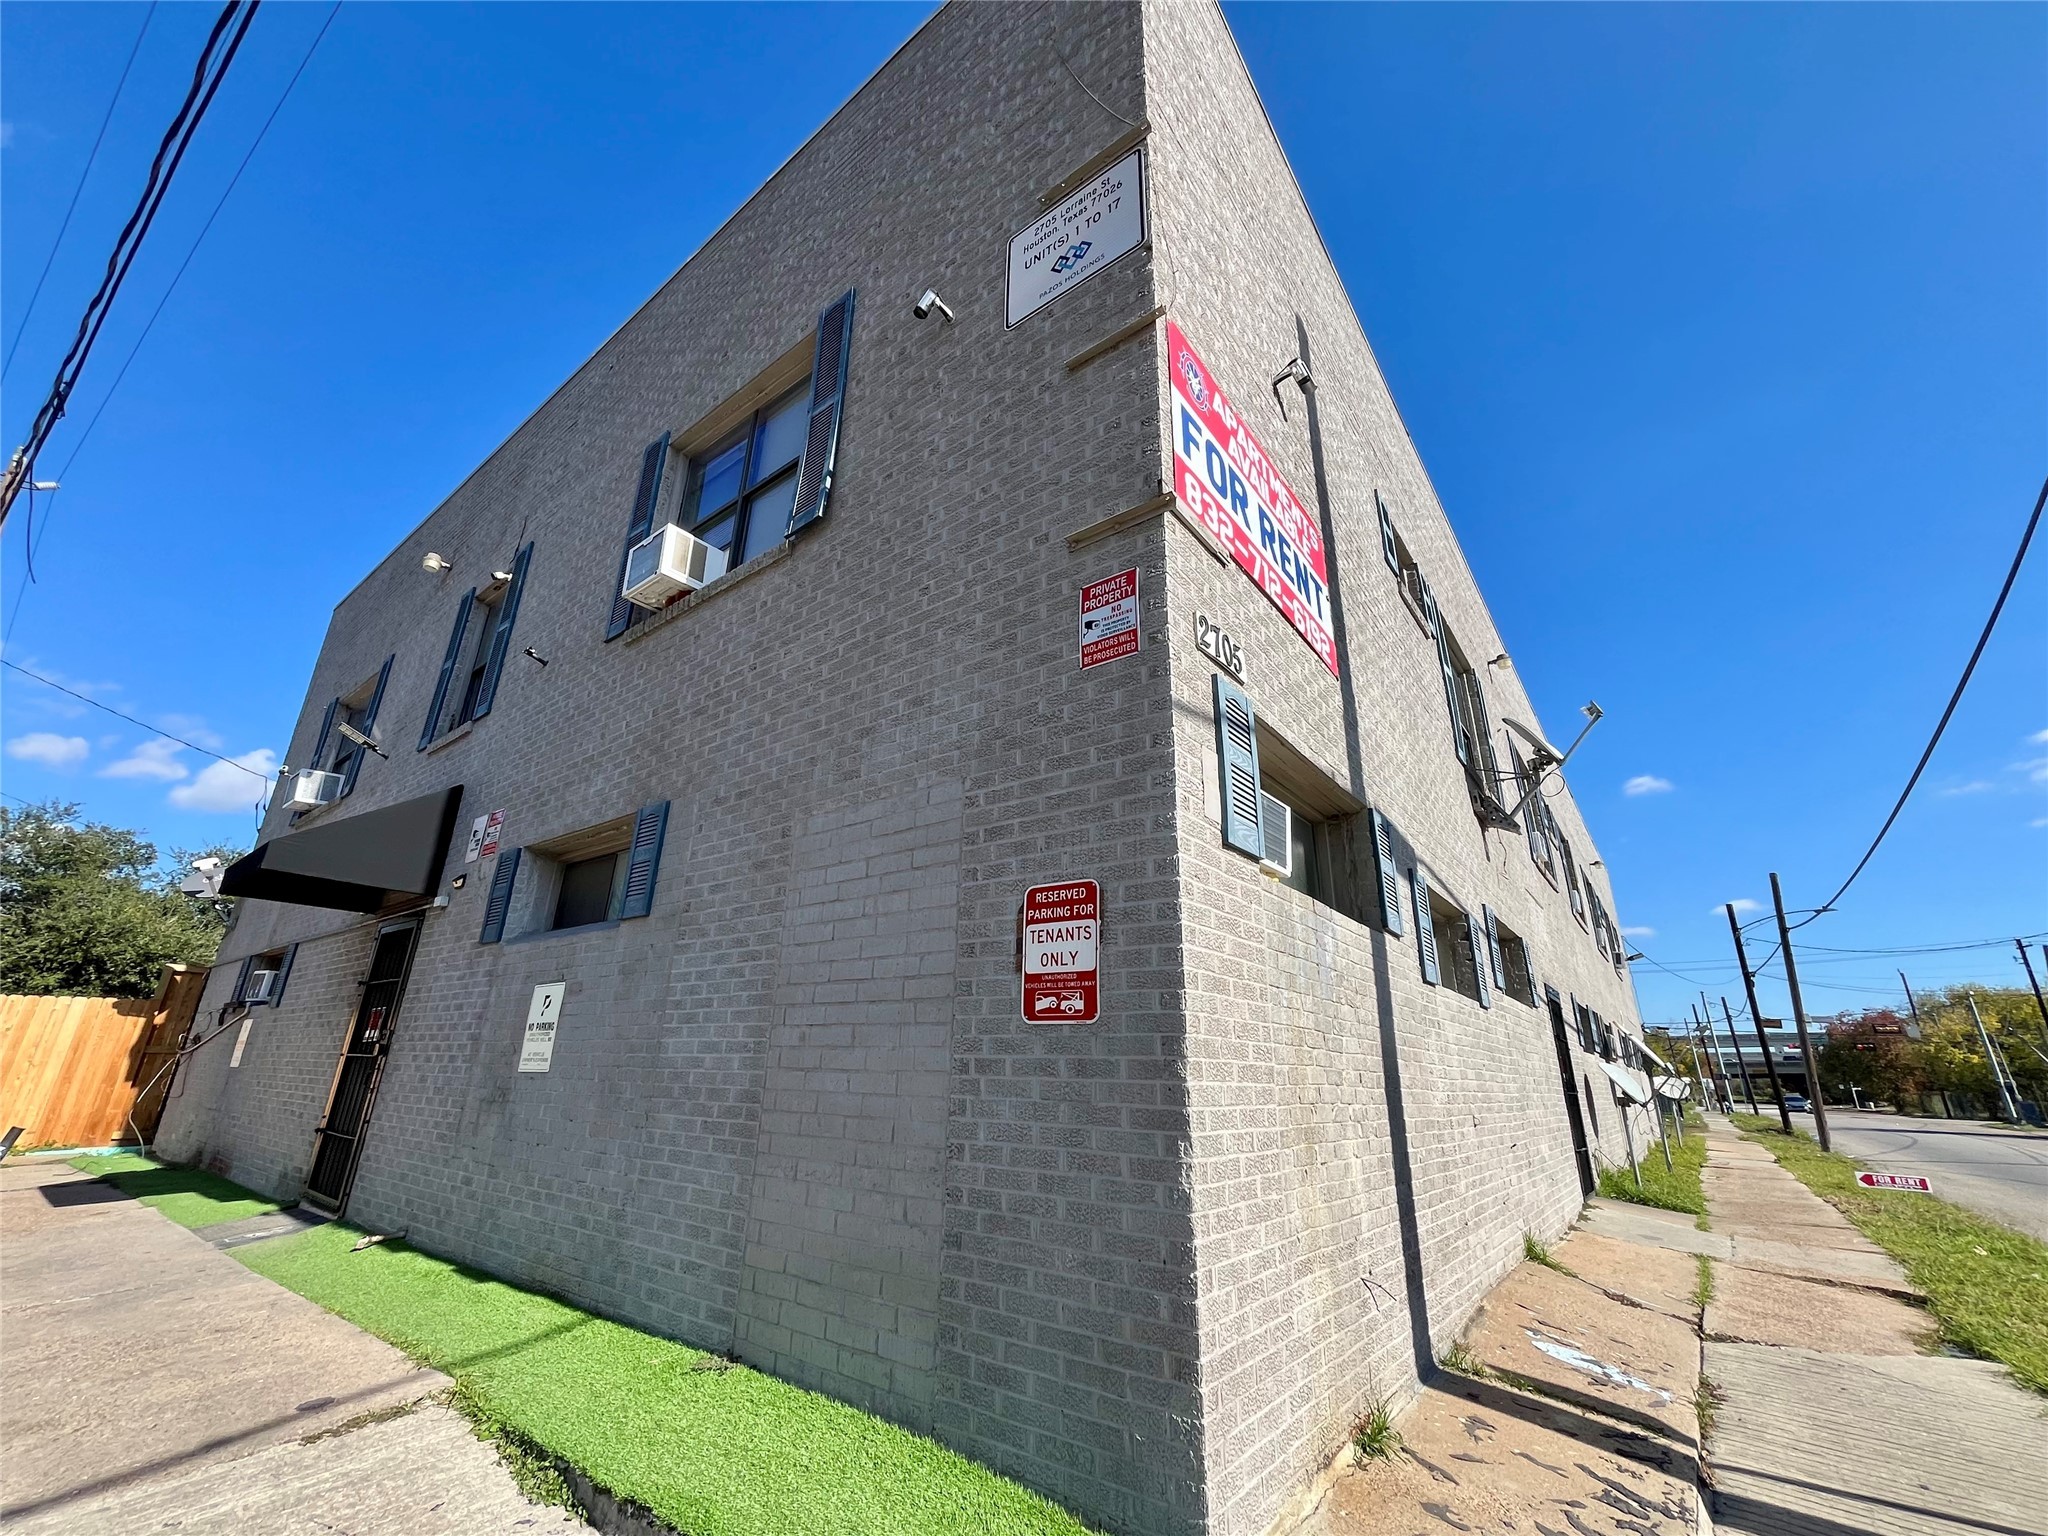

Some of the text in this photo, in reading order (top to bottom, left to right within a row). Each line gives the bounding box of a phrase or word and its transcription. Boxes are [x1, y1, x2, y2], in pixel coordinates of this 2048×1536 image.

[1034, 177, 1111, 237] 2705 Lorraine St
[1063, 205, 1088, 227] Texas
[1091, 180, 1123, 207] 77026
[1024, 197, 1122, 270] UNIT(S) 1 TO 17
[1039, 253, 1106, 299] PAZOS HOLDINGS
[1212, 391, 1319, 551] APARTMENTS
[1181, 403, 1323, 621] FOR RENT
[1227, 435, 1314, 566] AVAILABLE
[1184, 471, 1333, 667] 832-712-6192
[1084, 584, 1133, 612] PROPERTY
[1089, 575, 1128, 599] PRIVATE
[1111, 603, 1122, 613] NO
[1083, 631, 1136, 655] VIOLATORS WILL
[1083, 641, 1136, 665] BE PROSECUTED
[1198, 614, 1243, 675] 2705
[1035, 887, 1086, 904] RESERVED
[1027, 903, 1094, 920] PARKING FOR
[1029, 925, 1092, 944] TENANTS
[1040, 950, 1079, 967] ONLY
[528, 1021, 555, 1031] NO PARKING
[1872, 1175, 1921, 1186] FOR RENT
